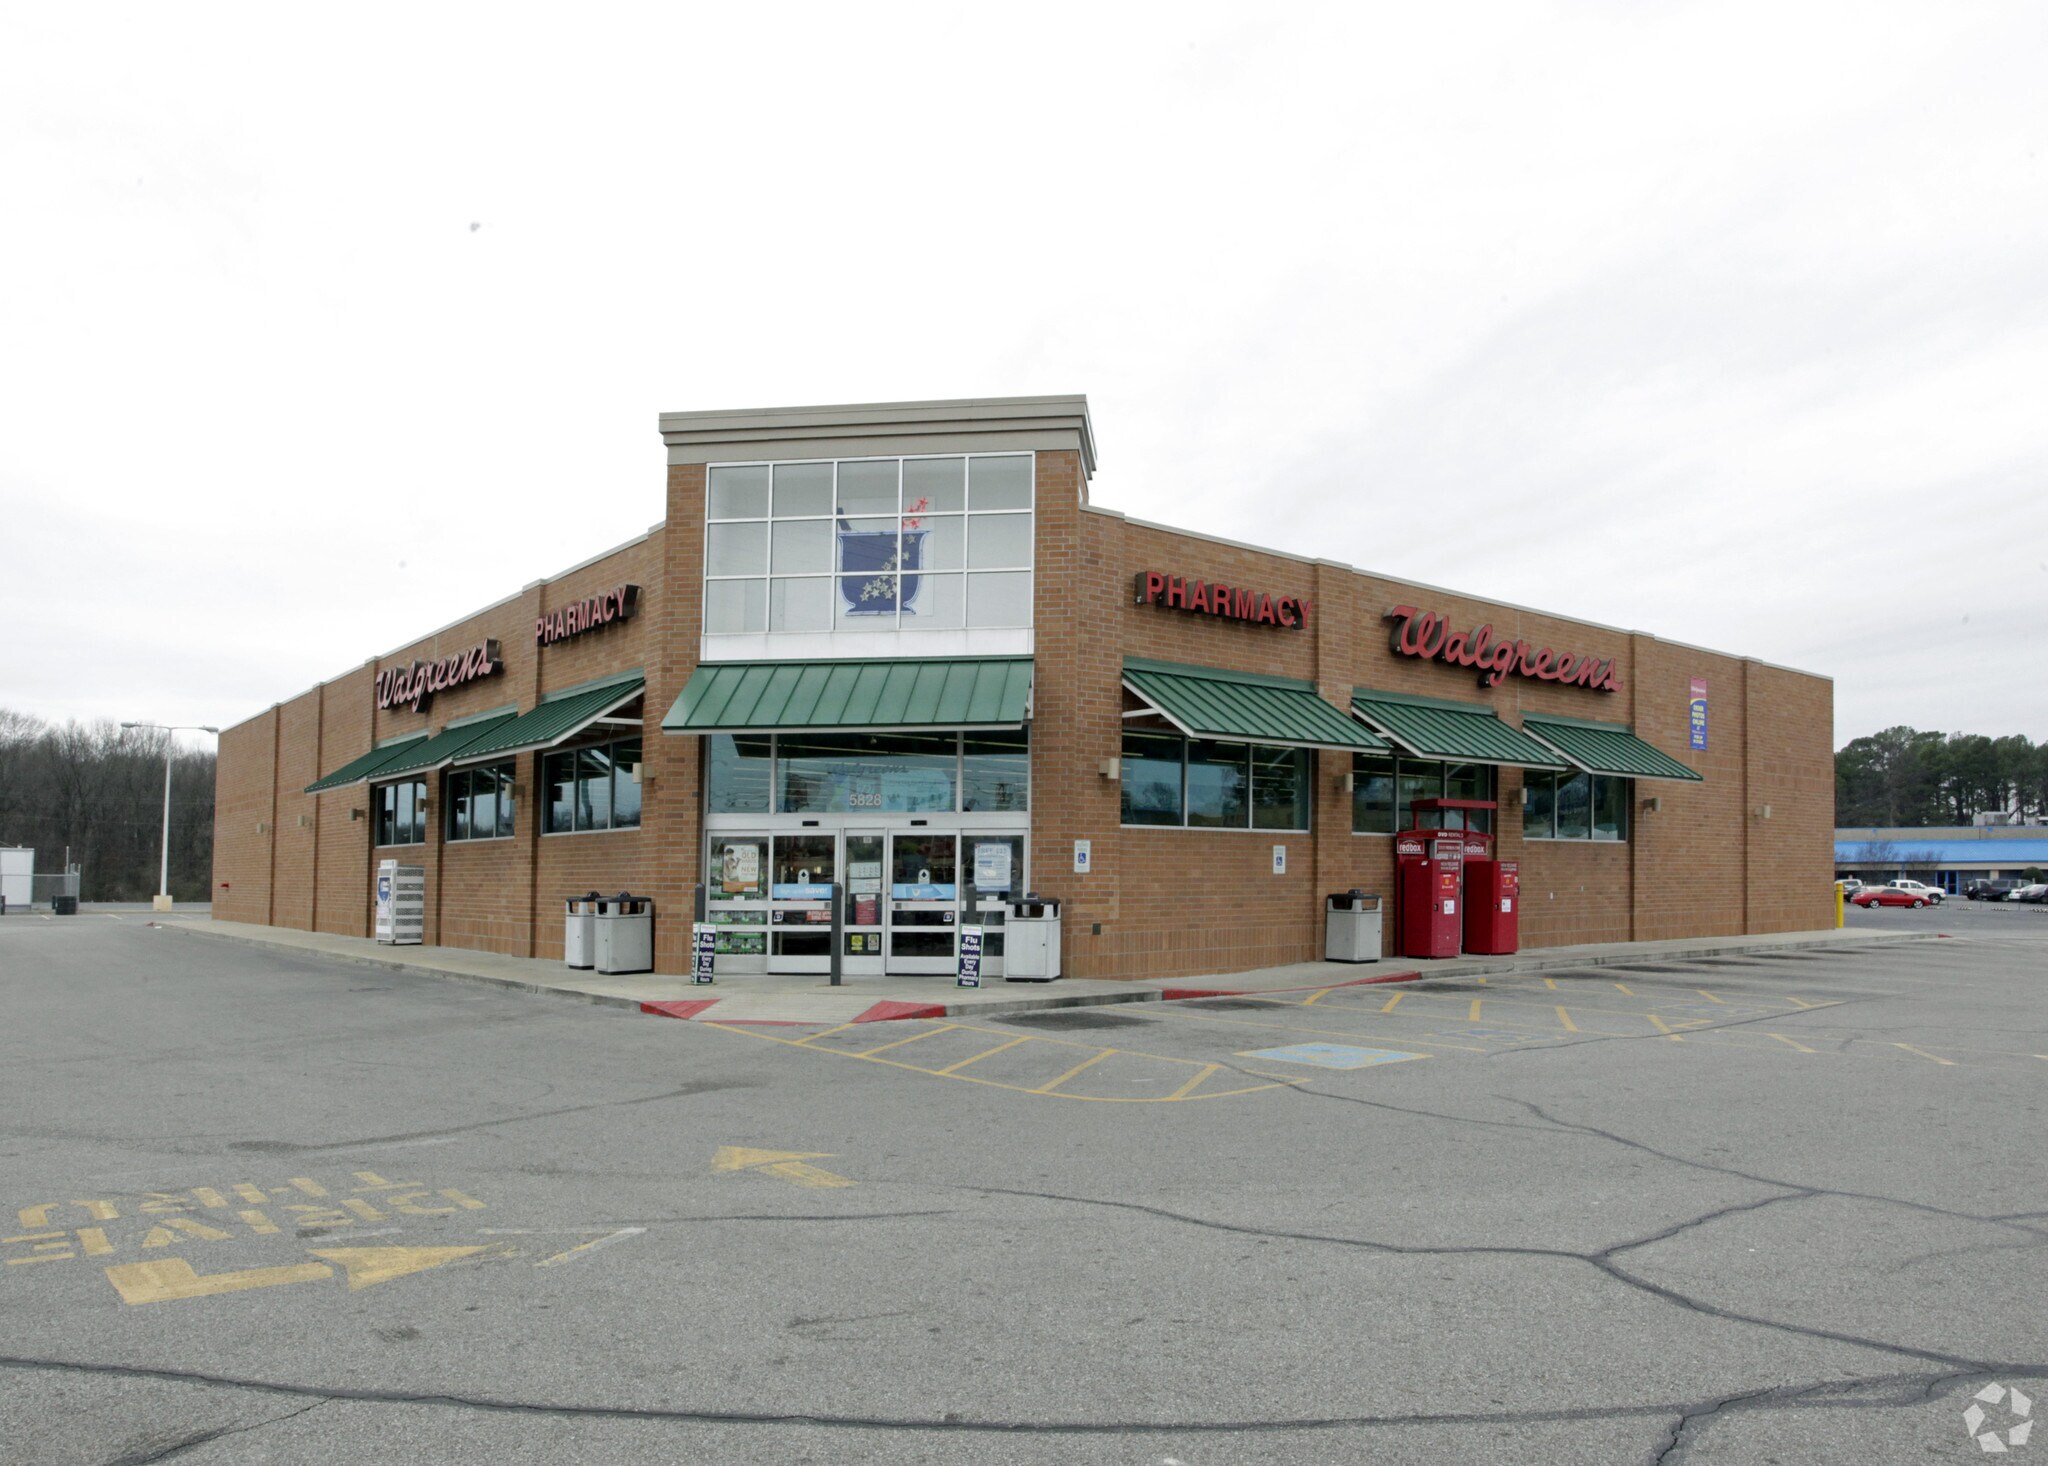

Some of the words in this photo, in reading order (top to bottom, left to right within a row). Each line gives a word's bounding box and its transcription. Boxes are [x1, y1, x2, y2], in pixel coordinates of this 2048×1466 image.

[535, 584, 628, 645] PHARMACY
[1146, 570, 1312, 630] PHARMACY
[376, 638, 493, 713] Walgreens
[1391, 604, 1623, 691] Walgreens
[849, 793, 881, 806] 5828
[1399, 843, 1422, 852] redbox
[1464, 844, 1485, 853] redbox
[961, 943, 980, 951] Shots
[2, 1187, 487, 1265] DRIVE
[18, 1170, 424, 1227] THRU
